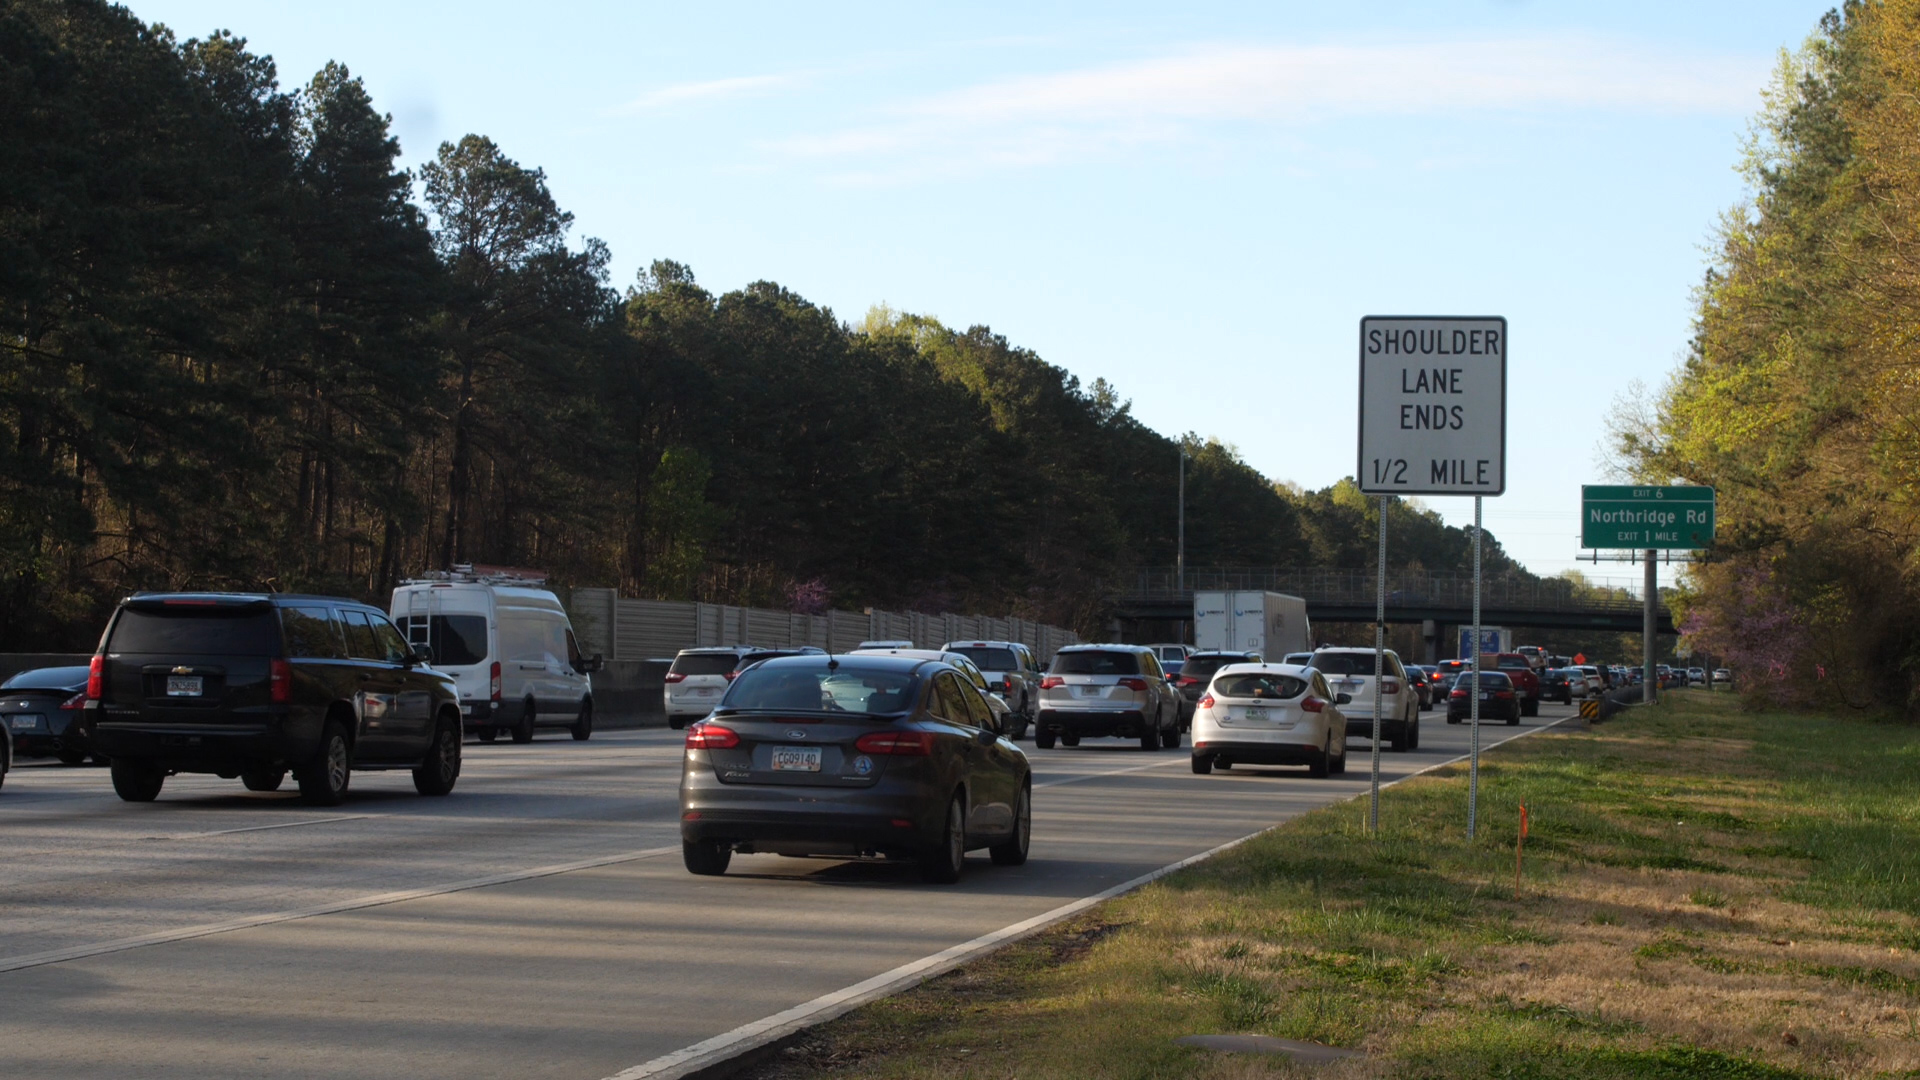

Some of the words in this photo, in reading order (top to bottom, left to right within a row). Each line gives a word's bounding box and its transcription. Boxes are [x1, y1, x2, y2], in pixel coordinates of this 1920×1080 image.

[1368, 329, 1499, 355] SHOULDER
[1402, 368, 1463, 394] LANE
[1400, 404, 1463, 430] ENDS
[1373, 458, 1408, 484] 1/2
[1431, 459, 1490, 485] MILE
[1633, 489, 1650, 497] EXIT
[1655, 488, 1663, 499] 6
[1590, 508, 1676, 527] Northridge
[1686, 509, 1706, 524] Rd
[1617, 531, 1638, 541] EXIT
[1645, 530, 1650, 542] 1
[1655, 531, 1678, 541] MILE
